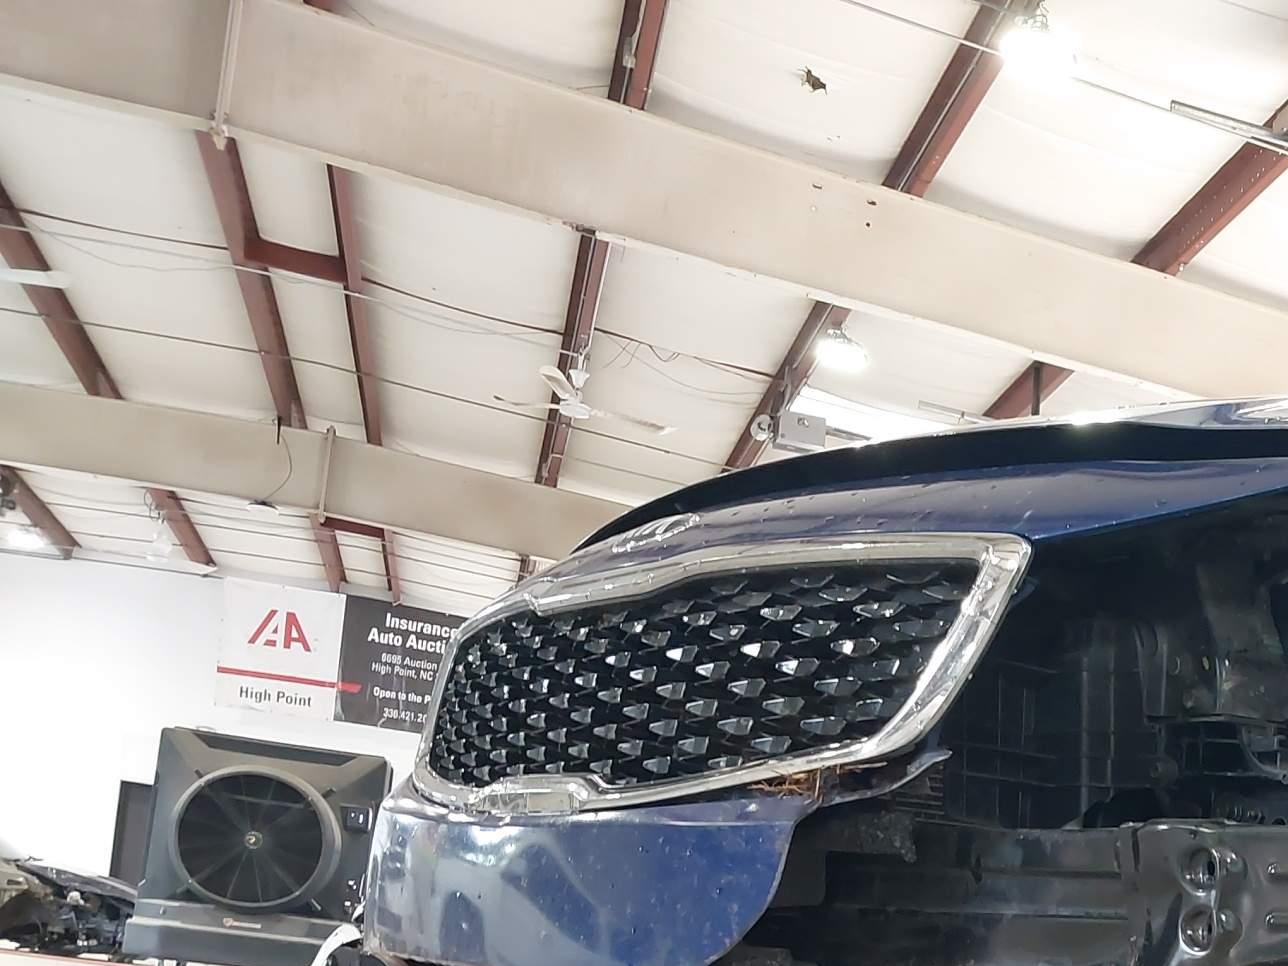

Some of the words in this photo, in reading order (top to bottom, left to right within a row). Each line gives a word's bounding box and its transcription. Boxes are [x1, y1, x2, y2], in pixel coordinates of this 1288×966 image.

[368, 628, 403, 647] Auto
[406, 634, 447, 654] Aucti
[371, 662, 392, 676] High
[394, 666, 418, 680] Point,
[419, 671, 434, 681] NC
[403, 656, 438, 671] Auction
[239, 685, 271, 704] High
[276, 691, 312, 708] Point
[373, 686, 396, 699] Open
[398, 692, 407, 701] to
[408, 694, 423, 704] the
